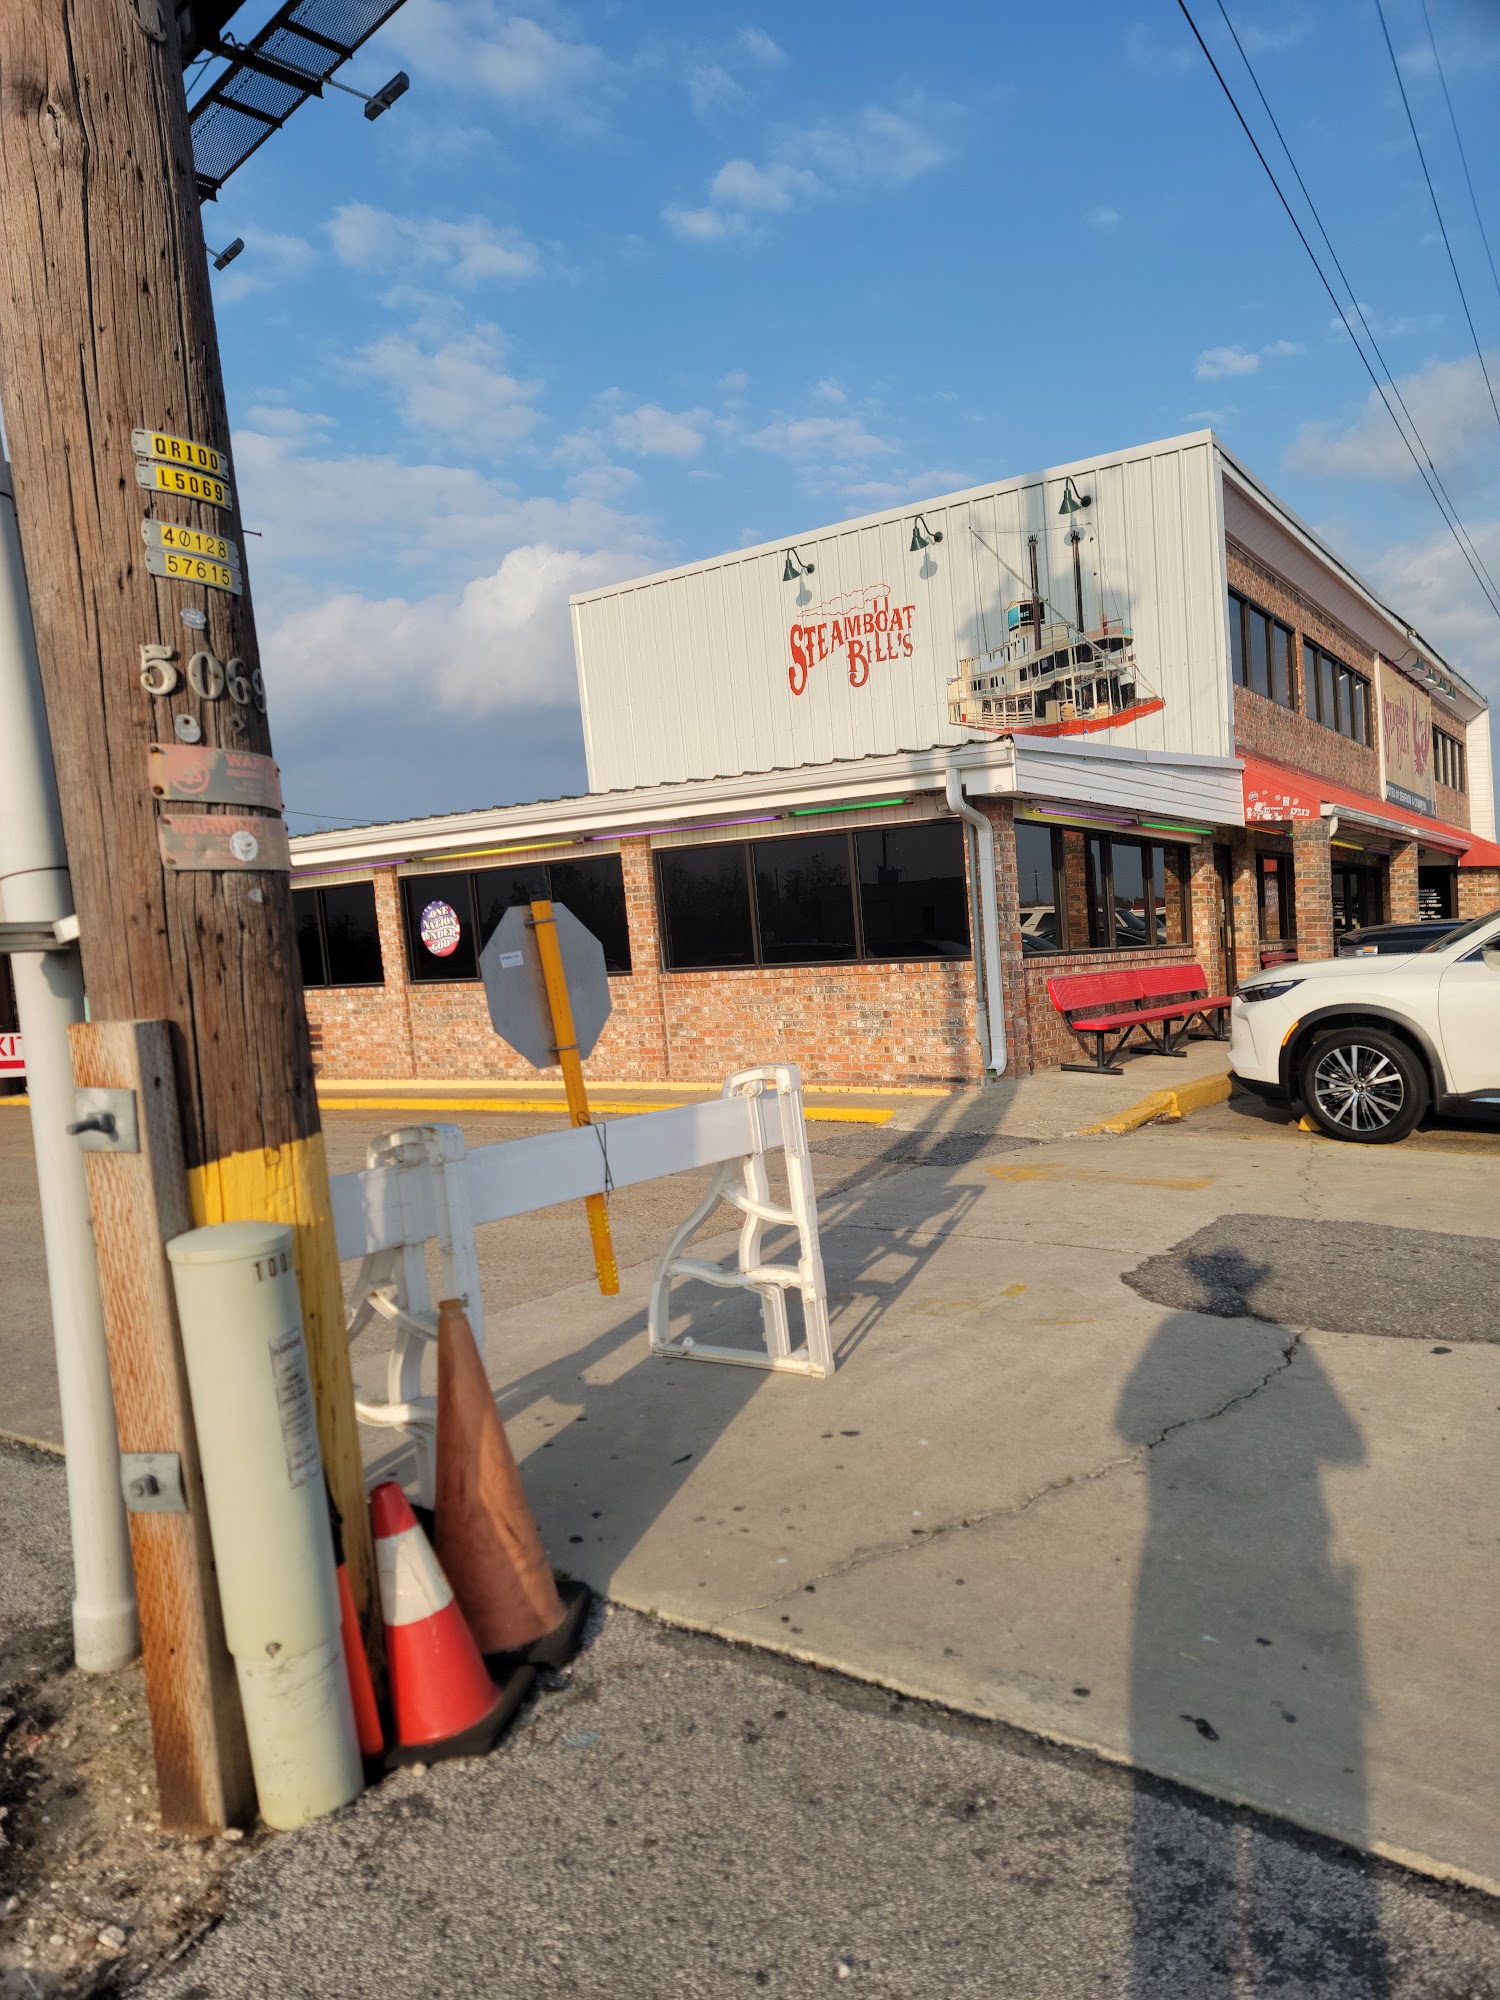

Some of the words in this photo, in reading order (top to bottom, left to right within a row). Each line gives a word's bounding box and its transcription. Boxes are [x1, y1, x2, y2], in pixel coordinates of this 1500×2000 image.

[155, 438, 219, 470] QR100
[161, 473, 223, 501] L5069
[167, 555, 230, 586] 57615
[788, 605, 916, 696] STEAMBOAT
[847, 632, 913, 688] BILL'S
[139, 643, 267, 714] 5069
[171, 818, 263, 836] WARNING
[422, 917, 457, 930] NATION
[429, 905, 449, 919] ONE
[424, 927, 457, 941] UNDER
[431, 939, 451, 952] GOD
